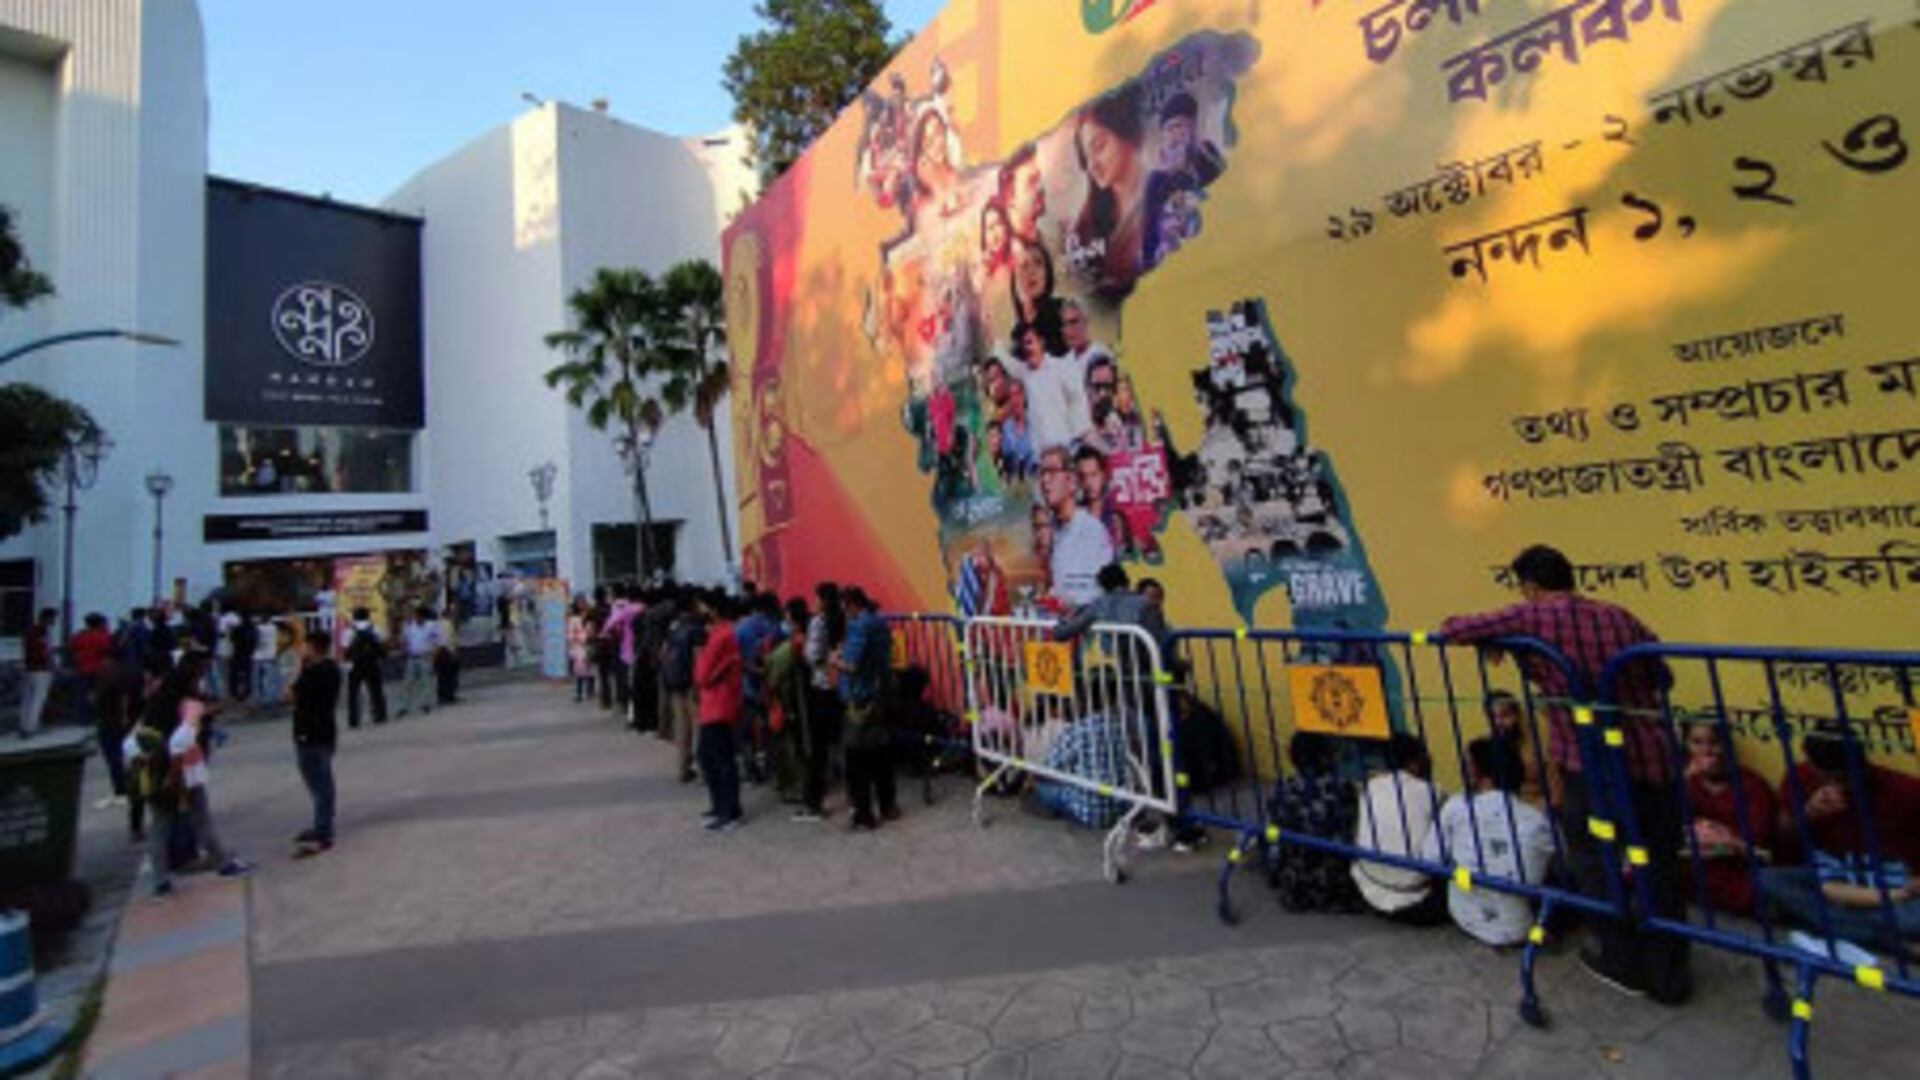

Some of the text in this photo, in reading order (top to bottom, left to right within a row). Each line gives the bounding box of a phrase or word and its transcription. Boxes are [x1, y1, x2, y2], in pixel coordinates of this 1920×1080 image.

[1440, 0, 1683, 102] কলকা
[1327, 207, 1374, 243] ২৯
[1383, 140, 1543, 217] অক্টোবর
[1602, 114, 1636, 146] ২
[1650, 19, 1875, 126] নভেম্বর
[1443, 205, 1592, 285] নন্দন
[1732, 156, 1795, 206] ২
[1821, 114, 1908, 173] ও
[1513, 358, 1920, 444] তথ্য ও সম্প্রচার ম
[1717, 428, 1920, 483] বাংলাদে
[1658, 552, 1730, 591] উপ
